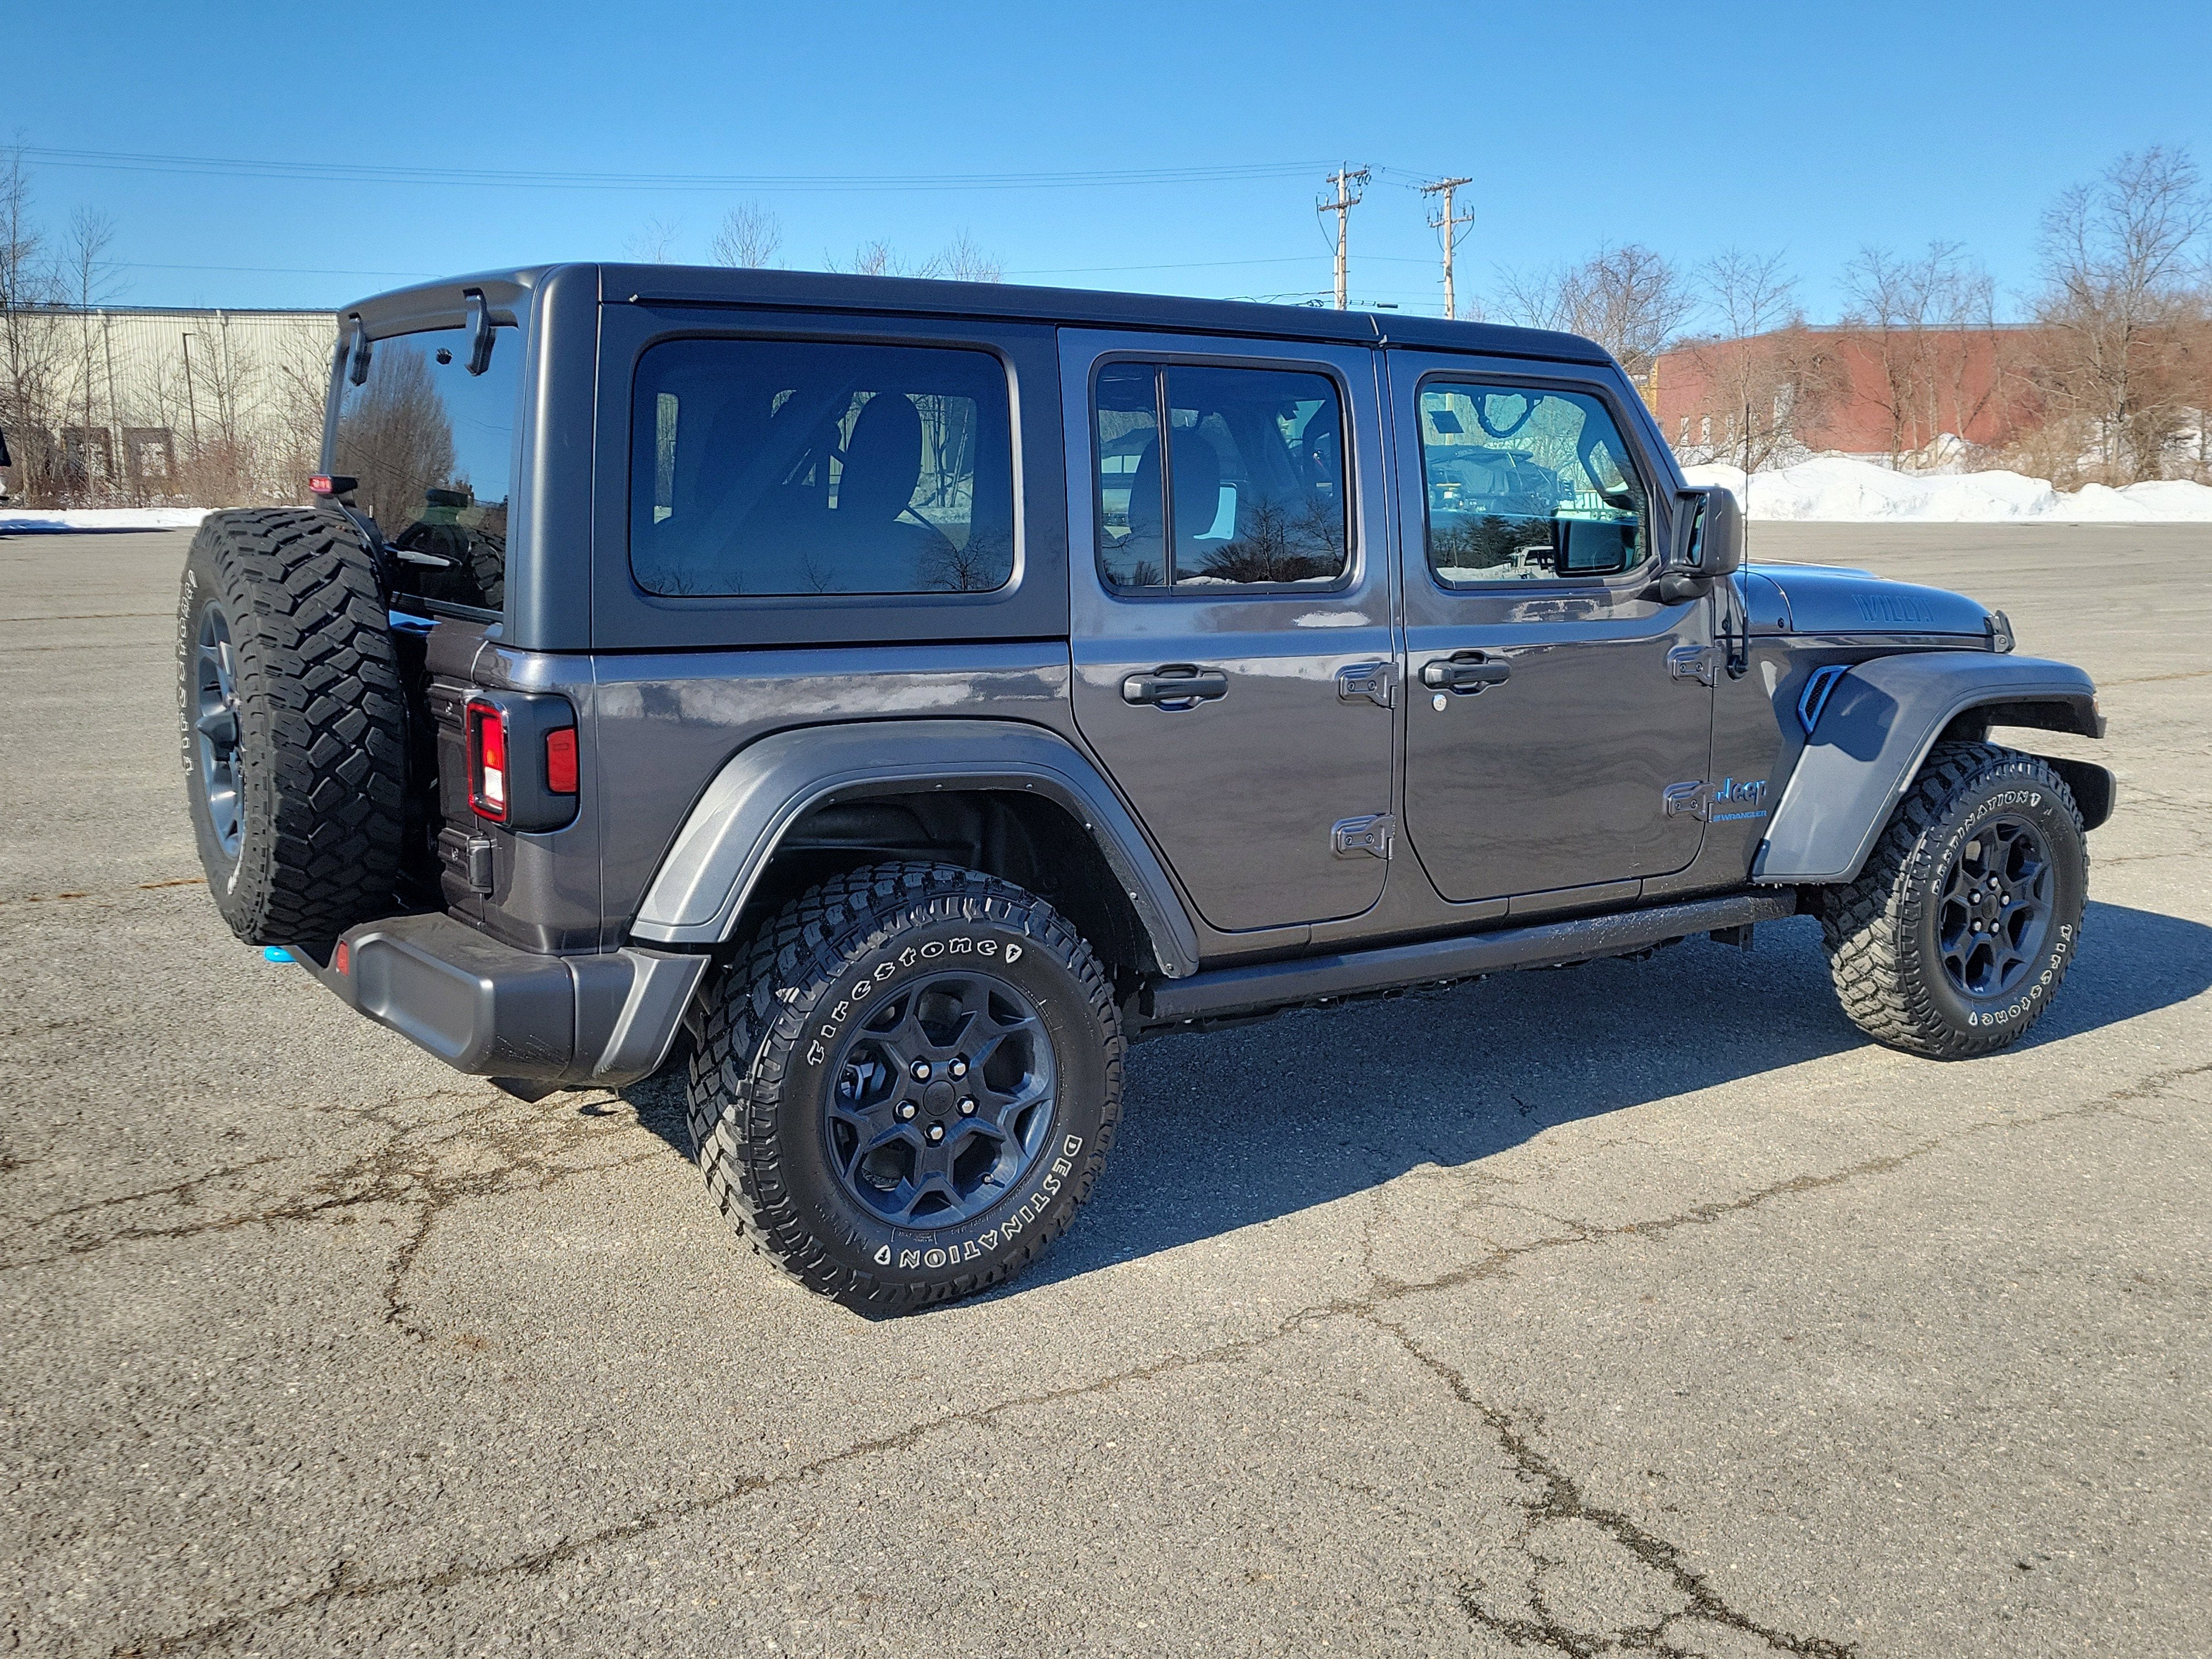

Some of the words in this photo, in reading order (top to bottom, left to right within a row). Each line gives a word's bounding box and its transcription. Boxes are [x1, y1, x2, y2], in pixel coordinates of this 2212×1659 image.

[1716, 777, 1767, 805] Jeep
[1722, 810, 1767, 821] WRANGLER
[1932, 791, 2029, 895] DESTINATION
[807, 937, 998, 1066] Firestone
[1980, 924, 2073, 1026] Firestone
[899, 1134, 1084, 1269] DESTINATION
